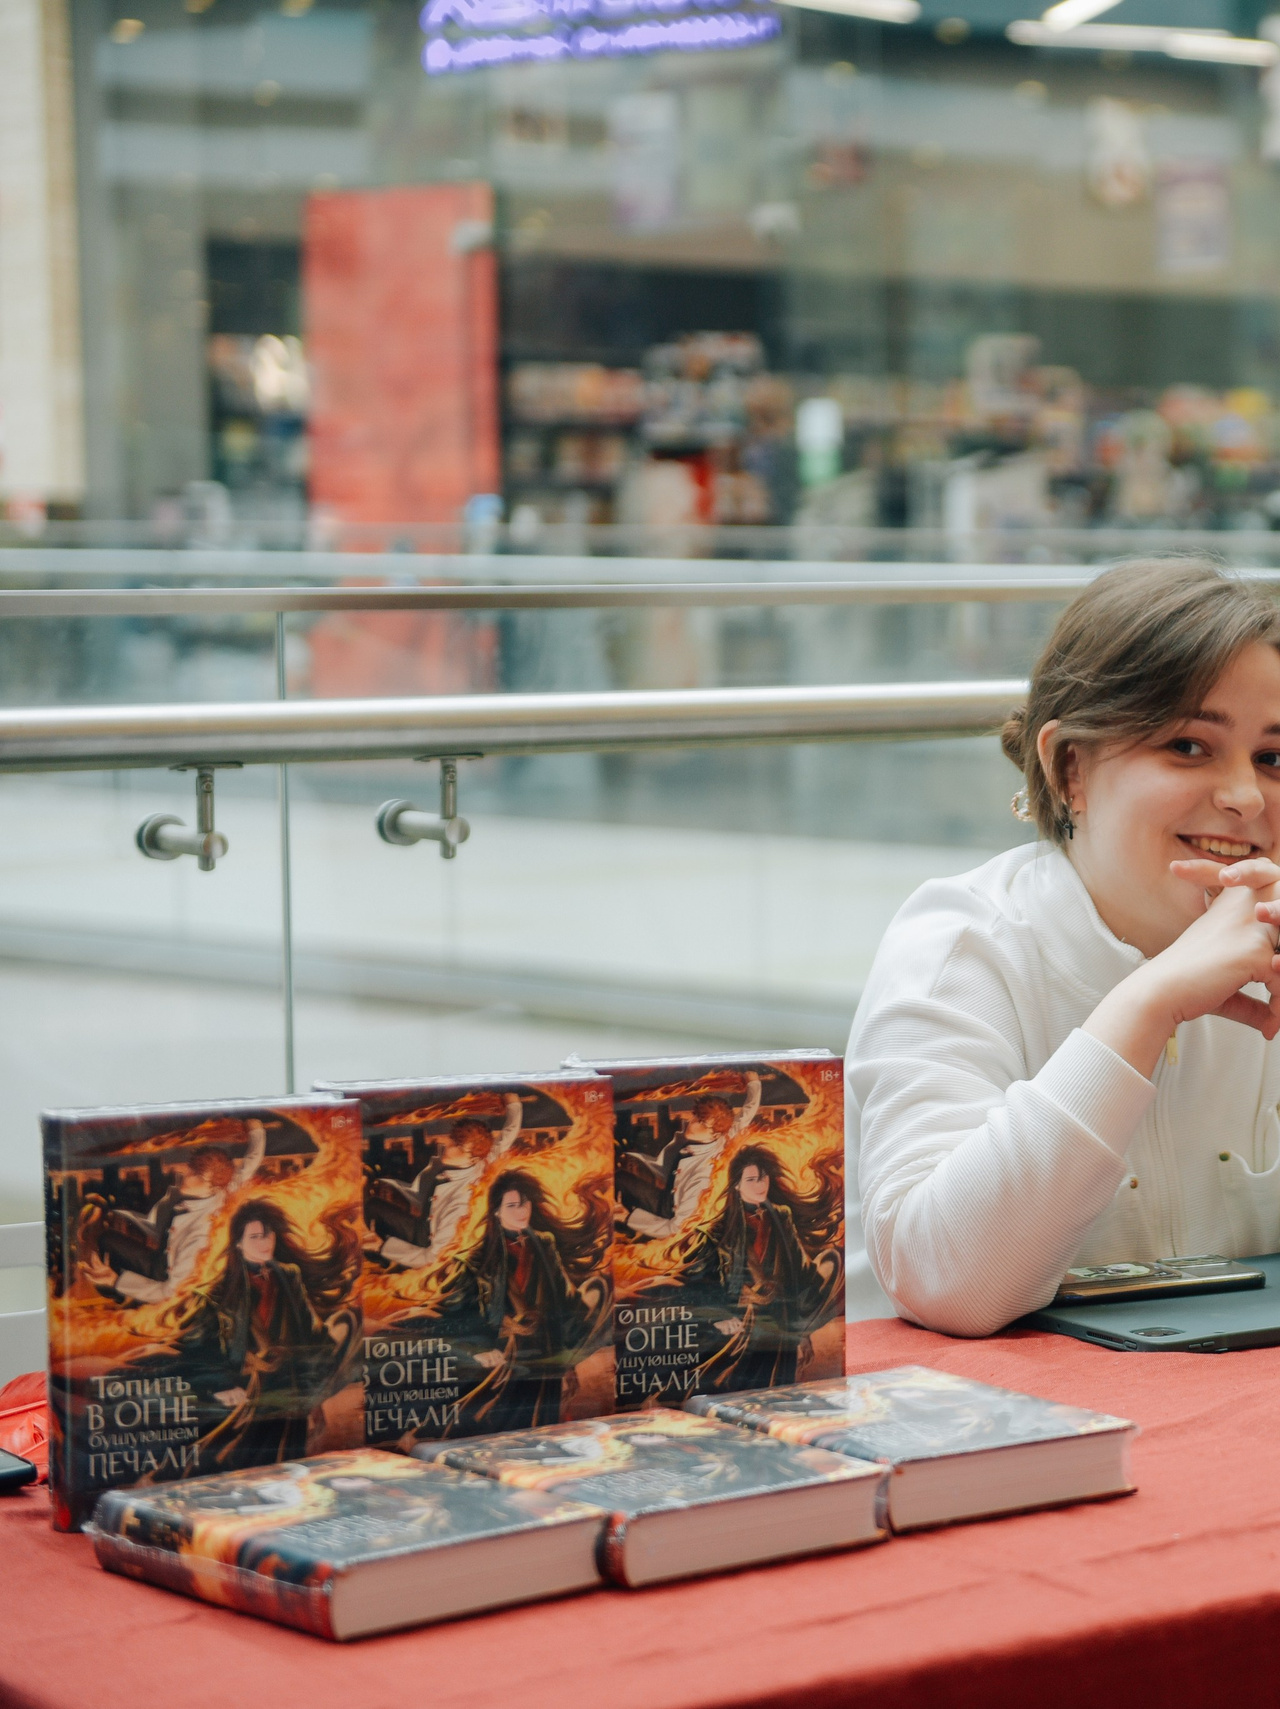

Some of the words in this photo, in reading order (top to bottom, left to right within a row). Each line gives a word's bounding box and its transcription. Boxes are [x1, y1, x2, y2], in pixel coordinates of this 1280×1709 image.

[820, 1069, 840, 1082] 18+
[583, 1090, 605, 1103] 18+
[625, 1323, 700, 1353] ОГНЕ
[380, 1356, 459, 1387] ОГНЕ
[615, 1352, 700, 1372] ушующем
[89, 1375, 192, 1399] Топить
[615, 1369, 701, 1399] ЕЧАЛИ
[86, 1404, 105, 1430] В
[114, 1395, 199, 1428] ОГНЕ
[88, 1426, 199, 1450] бушующем
[88, 1444, 200, 1480] ПЕЧАЛИ
